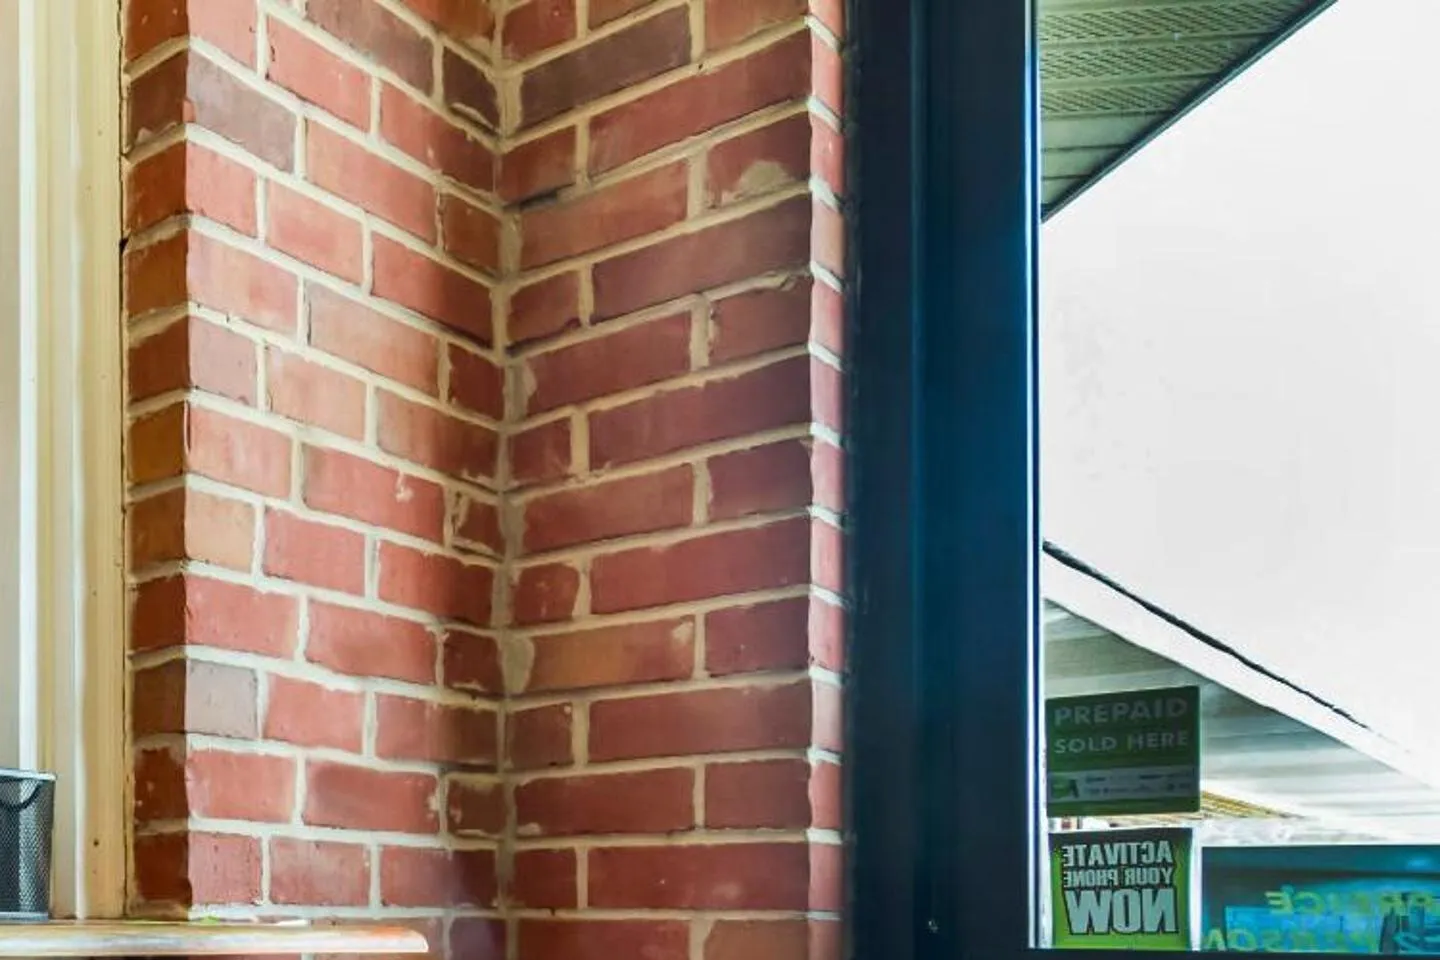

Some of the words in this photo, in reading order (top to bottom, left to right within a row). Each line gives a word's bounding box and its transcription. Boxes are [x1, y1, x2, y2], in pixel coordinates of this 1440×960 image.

[1054, 697, 1188, 727] PREPAID
[1055, 736, 1117, 754] SOLD
[1128, 730, 1189, 752] HERE
